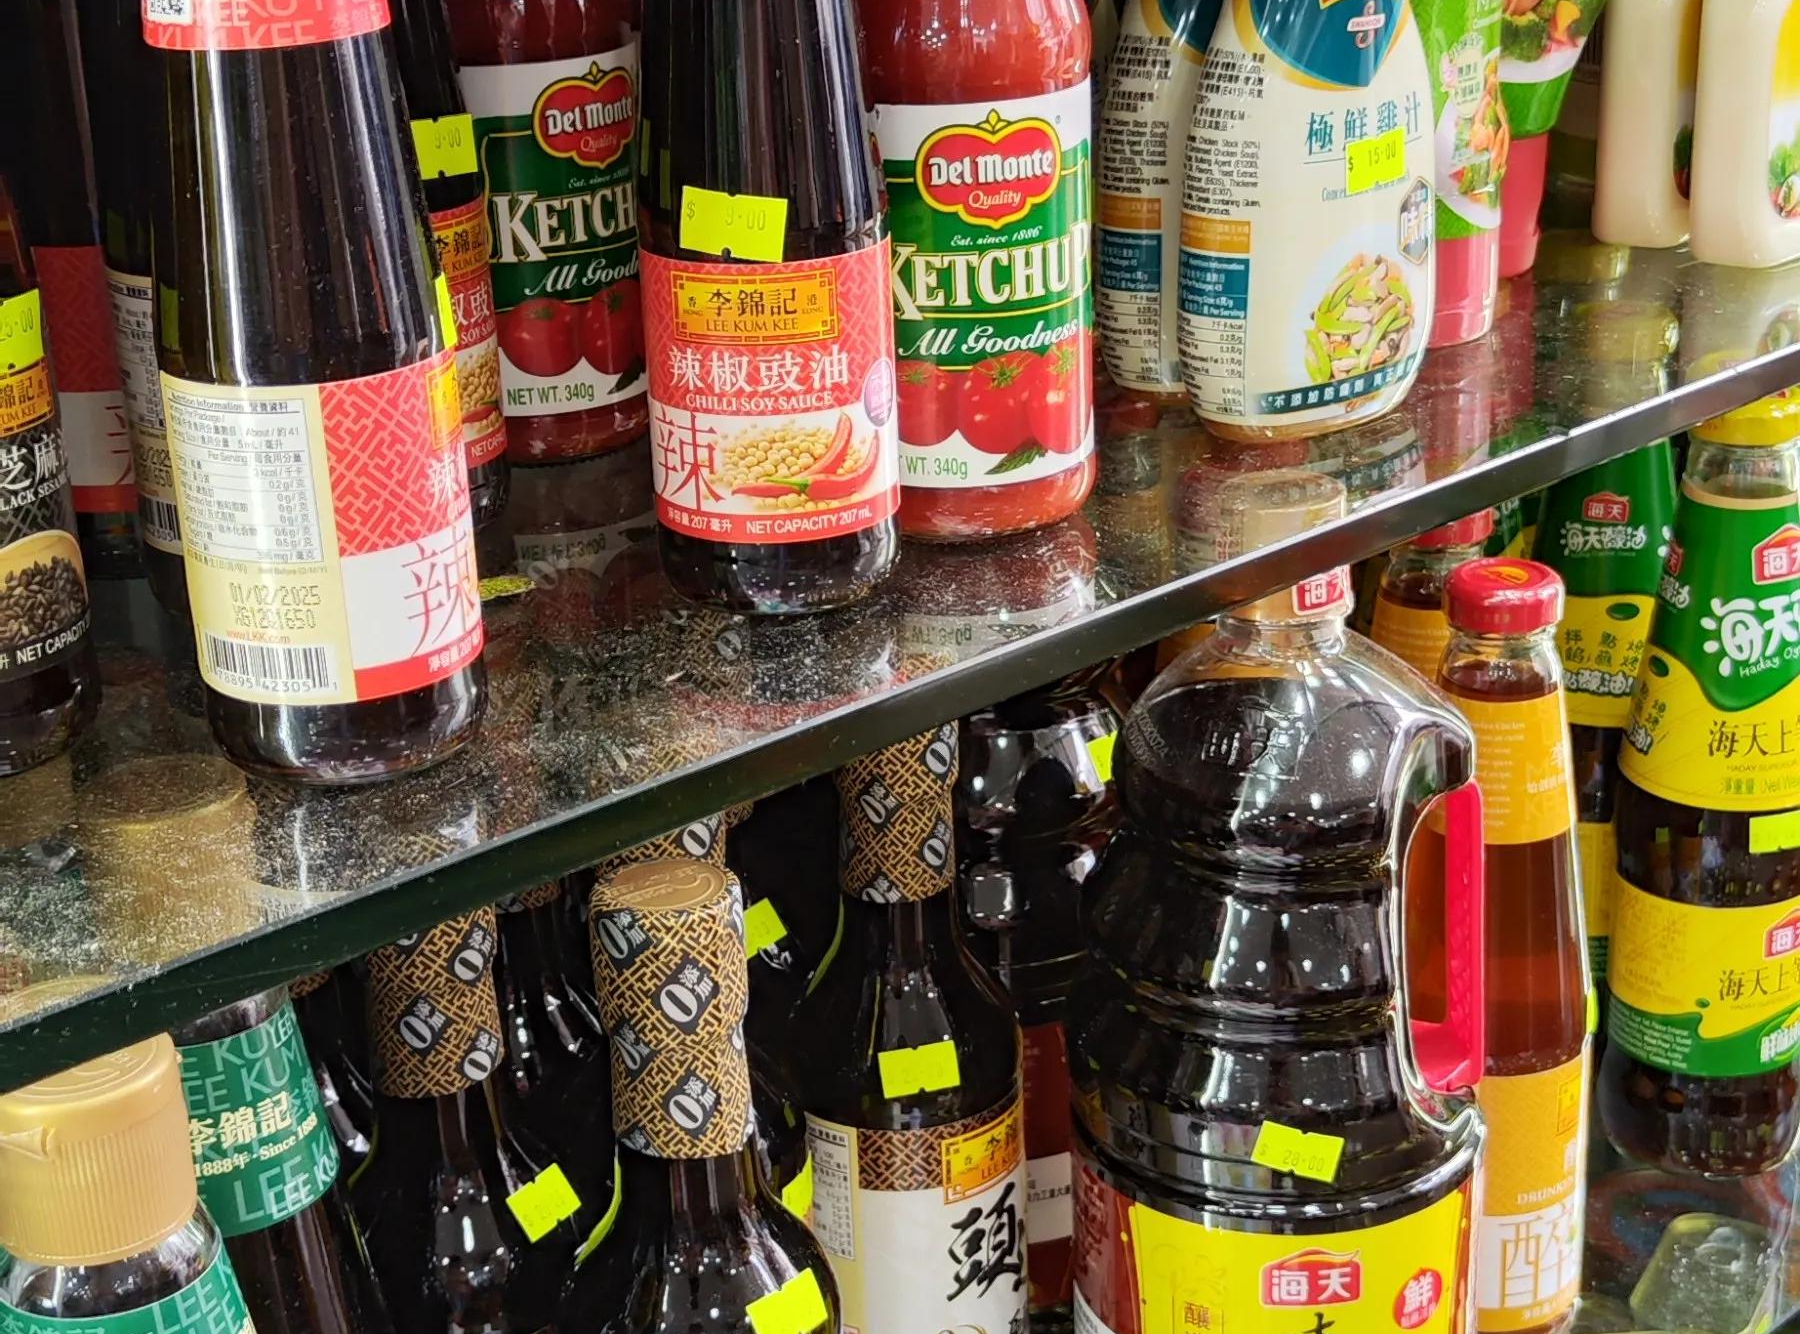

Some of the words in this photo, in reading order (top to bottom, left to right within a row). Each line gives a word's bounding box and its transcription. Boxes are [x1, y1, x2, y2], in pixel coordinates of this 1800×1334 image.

[544, 105, 583, 136] Del
[584, 96, 634, 132] Monte
[1304, 91, 1421, 157] 極鮮雞汁
[580, 133, 618, 154] Quality
[928, 155, 974, 187] Del
[975, 148, 1054, 185] Monte
[967, 187, 1022, 210] Quality
[950, 232, 974, 247] Est.
[976, 233, 1008, 245] since
[1011, 225, 1043, 242] 1886
[523, 267, 577, 297] All
[890, 220, 1092, 322] KETCHUP
[706, 287, 799, 317] 李錦記
[705, 319, 731, 333] LEE
[733, 319, 769, 333] KUM
[772, 317, 800, 332] KEE
[897, 326, 957, 357] All
[960, 316, 1079, 356] Goodness
[667, 344, 850, 395] 辣椒豉油
[507, 386, 535, 407] NET
[537, 384, 564, 405] WT.
[565, 381, 596, 404] 340g
[685, 392, 738, 413] CHILLI
[740, 394, 773, 413] SOY
[777, 389, 834, 411] SAUCE
[653, 403, 727, 512] 辣
[906, 457, 931, 475] WT.
[933, 457, 969, 480] 340g
[746, 516, 774, 535] NET
[776, 513, 838, 533] CAPACITY
[838, 508, 858, 525] 207
[1586, 501, 1626, 520] 海天
[228, 581, 322, 607] 01/02/2025
[16, 641, 44, 665] NET
[1738, 654, 1781, 679] Haday
[261, 680, 312, 694] 42305
[258, 1135, 297, 1161] Since
[1270, 1265, 1354, 1305] 海天
